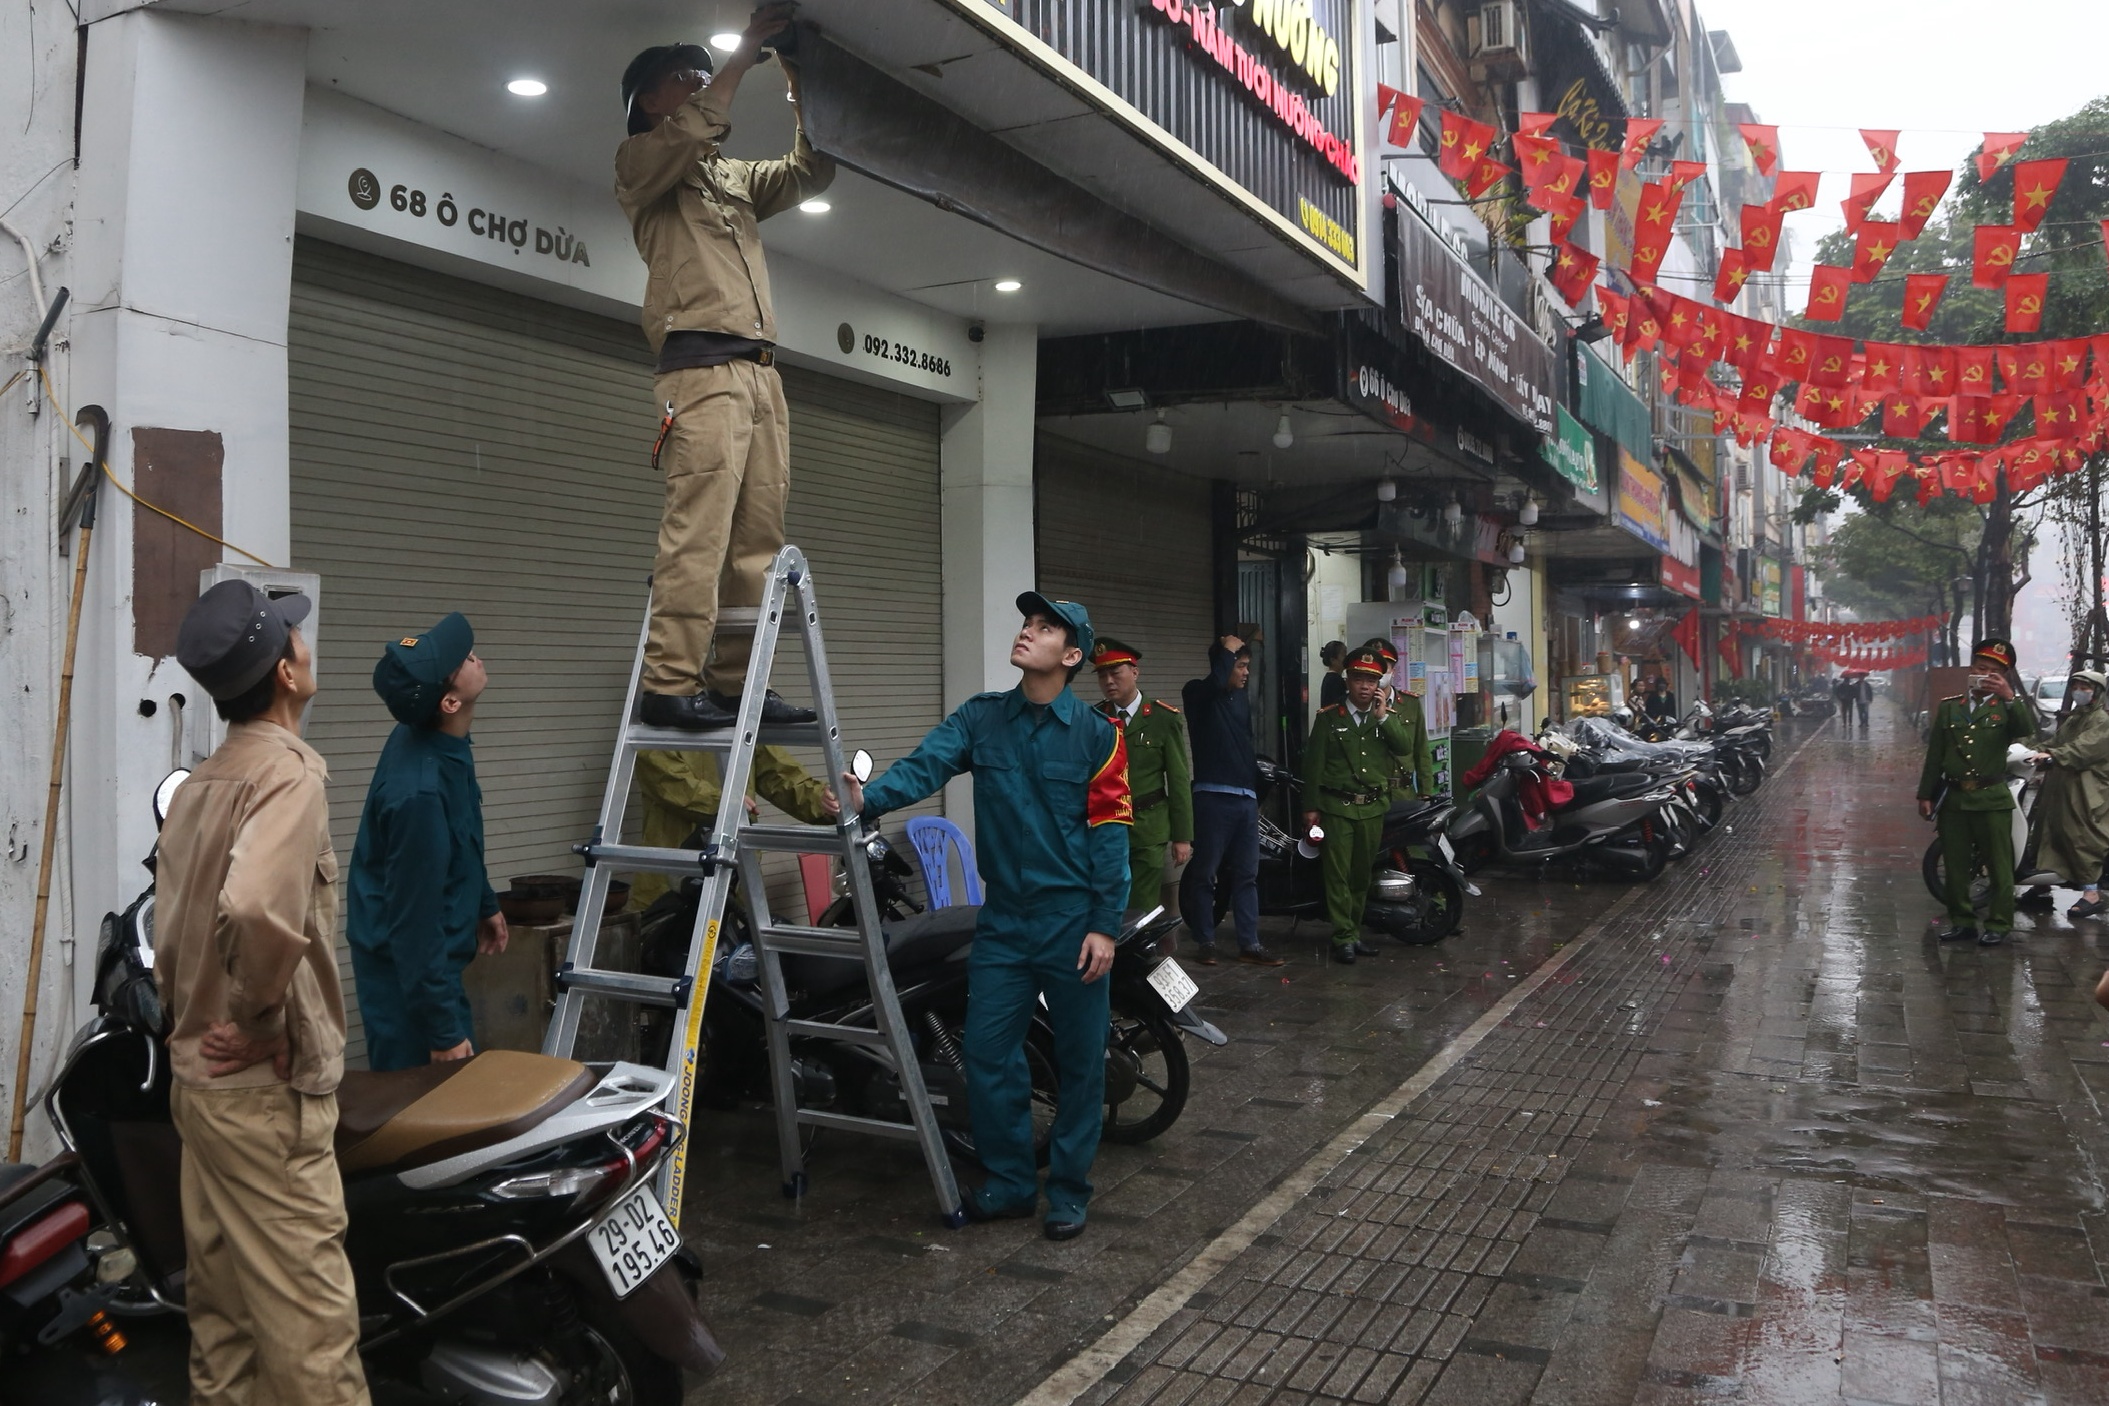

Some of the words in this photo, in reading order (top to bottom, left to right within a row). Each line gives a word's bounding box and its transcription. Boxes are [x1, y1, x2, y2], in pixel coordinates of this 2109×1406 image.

[1235, 43, 1272, 108] TƯƠI
[1274, 79, 1325, 153] NƯỚNG
[390, 185, 427, 217] 68
[437, 192, 458, 227] Ô
[468, 208, 528, 256] CHỢ
[536, 226, 590, 268] DỪA
[1416, 284, 1434, 323] SA
[1461, 271, 1501, 330] MOBILE
[864, 334, 951, 378] 092.332.8686
[1369, 367, 1379, 397] 66
[1153, 963, 1180, 990] 93-F1
[680, 1066, 692, 1120] JOONG
[598, 1194, 654, 1257] 29-D2
[612, 1219, 675, 1289] 195.46
